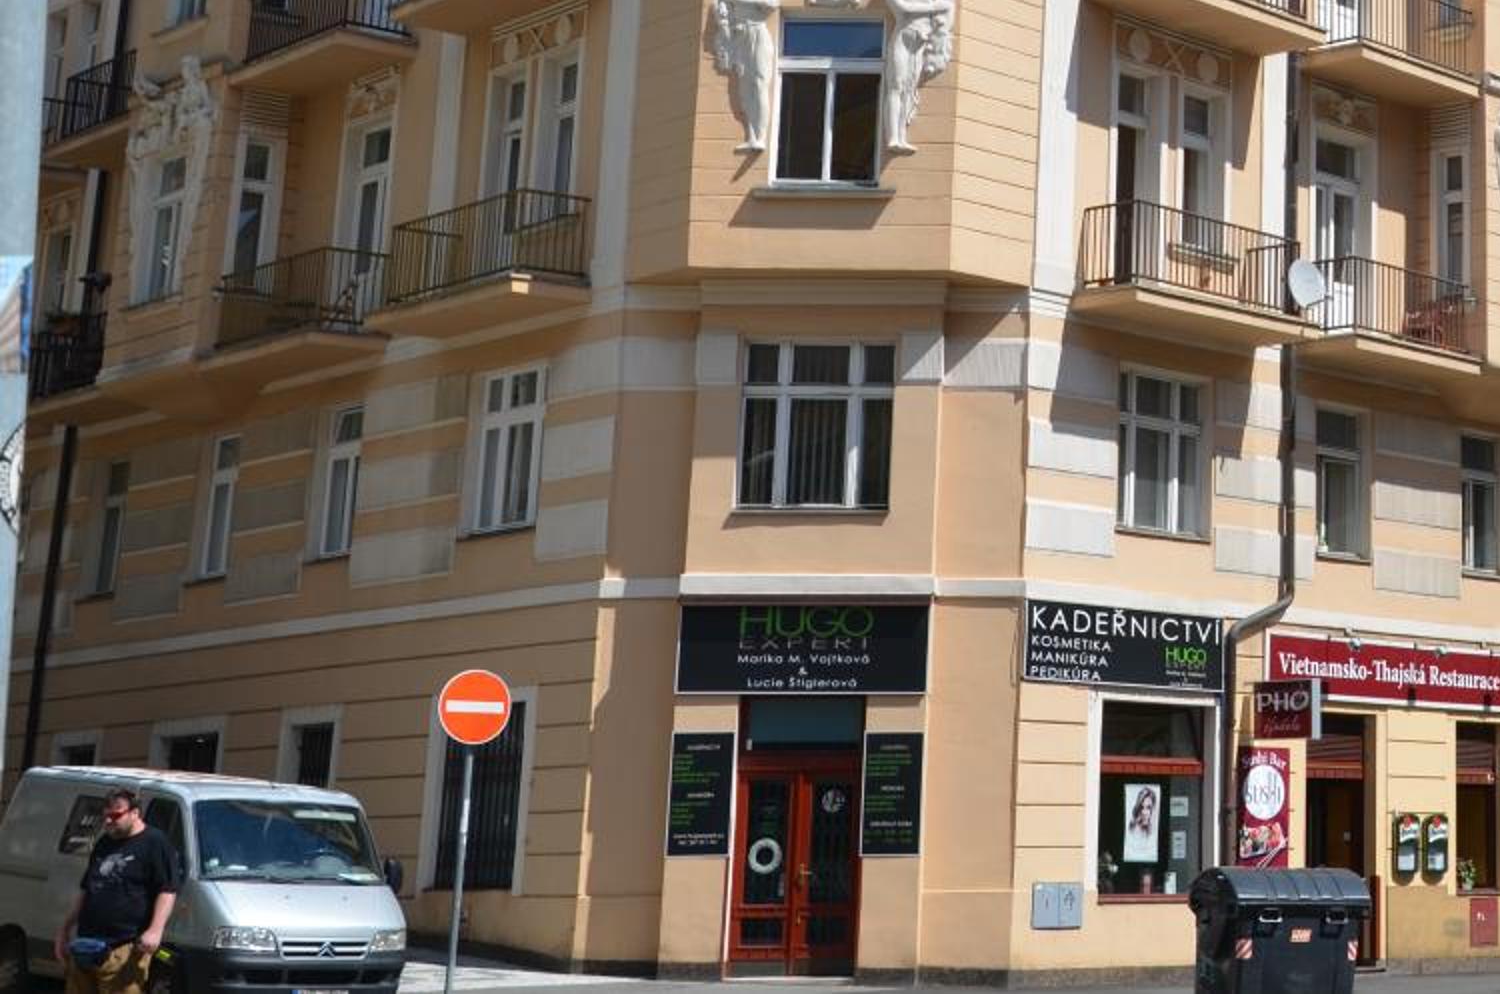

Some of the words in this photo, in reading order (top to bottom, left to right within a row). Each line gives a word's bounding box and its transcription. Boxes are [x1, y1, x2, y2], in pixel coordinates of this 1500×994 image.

[739, 606, 875, 637] HUGO
[1032, 605, 1220, 645] KADEŘNICTVÍ
[1031, 635, 1112, 652] KOSMETIKA
[1165, 646, 1207, 663] HUGO
[797, 666, 808, 677] &
[1030, 665, 1102, 682] PEDIKÚRA
[1429, 666, 1500, 690] Restaurace
[747, 677, 785, 688] Lucie
[1269, 751, 1288, 771] Bar
